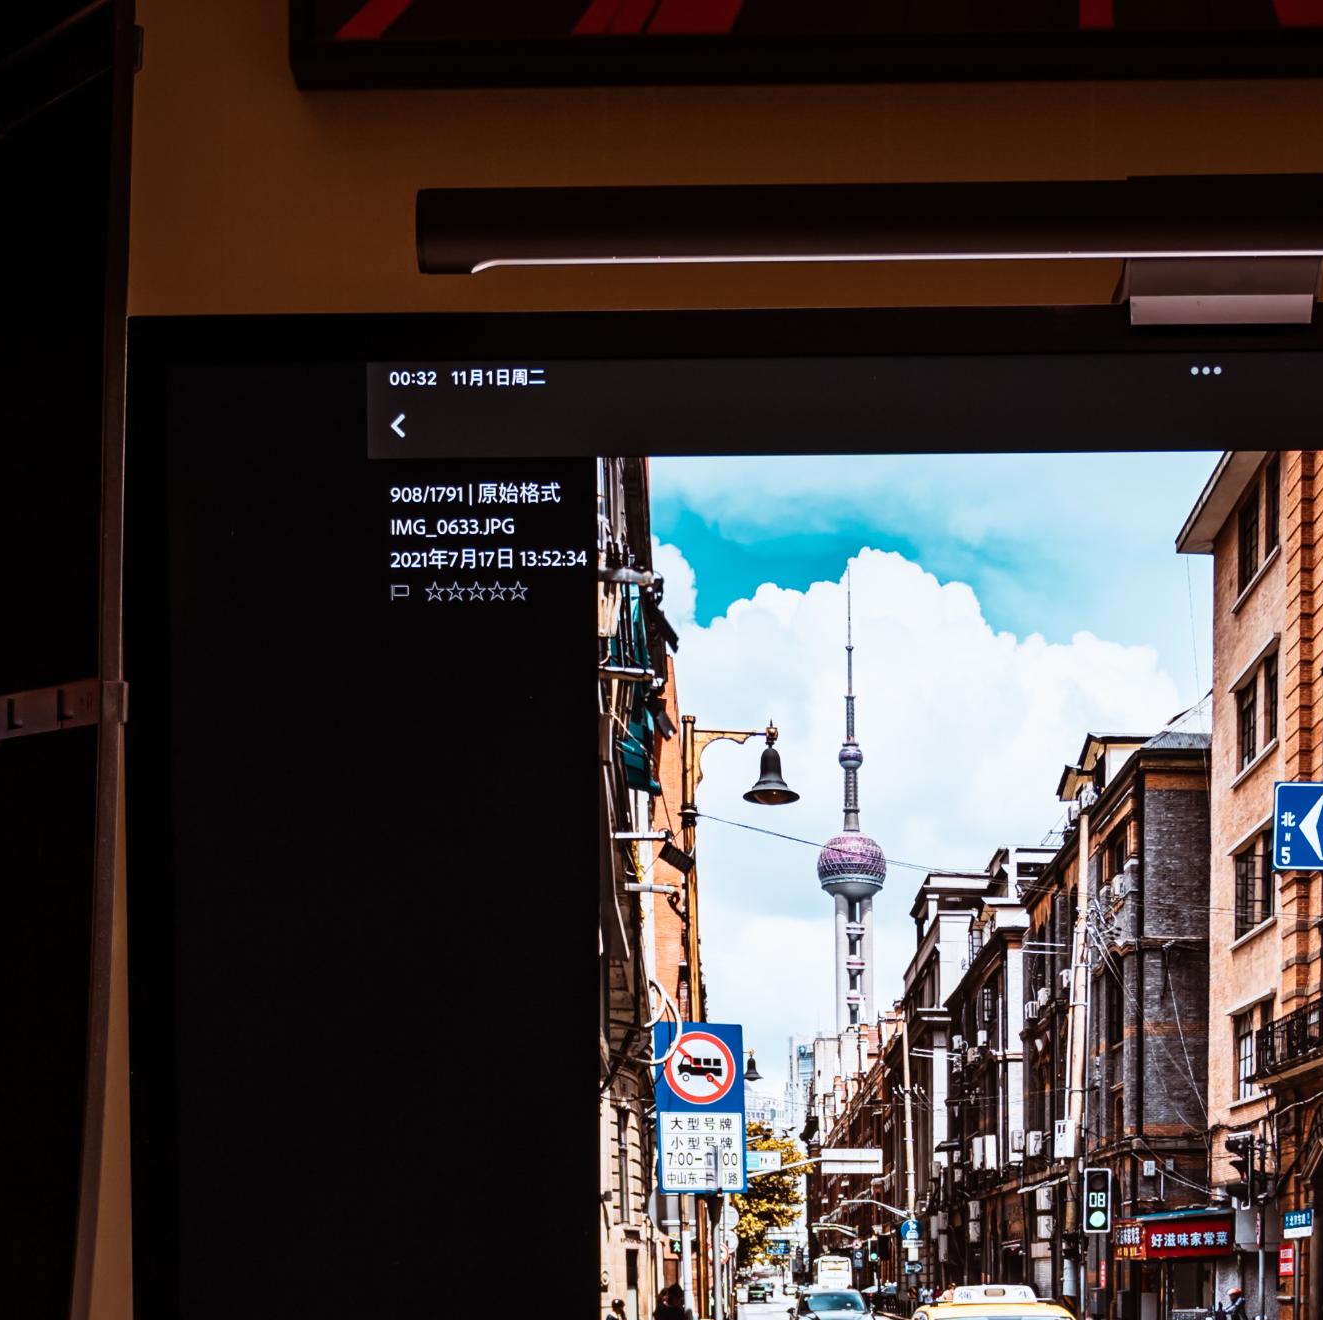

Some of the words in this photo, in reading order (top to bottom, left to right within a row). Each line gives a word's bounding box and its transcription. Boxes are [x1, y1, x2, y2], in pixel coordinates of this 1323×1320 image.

[389, 371, 437, 386] 00:32
[451, 369, 546, 386] 11月1日周二
[390, 486, 463, 503] 908/1791
[478, 482, 561, 504] 原始格式
[391, 518, 515, 537] IMG_0633.JPG
[390, 548, 513, 569] 2021年7月17日
[520, 551, 587, 566] 13:52:34
[1280, 811, 1296, 827] 北
[1281, 846, 1290, 864] 5
[670, 1117, 732, 1131] 大型号牌
[1089, 1192, 1106, 1207] 08
[1151, 1231, 1227, 1248] 好滋味家常菜
